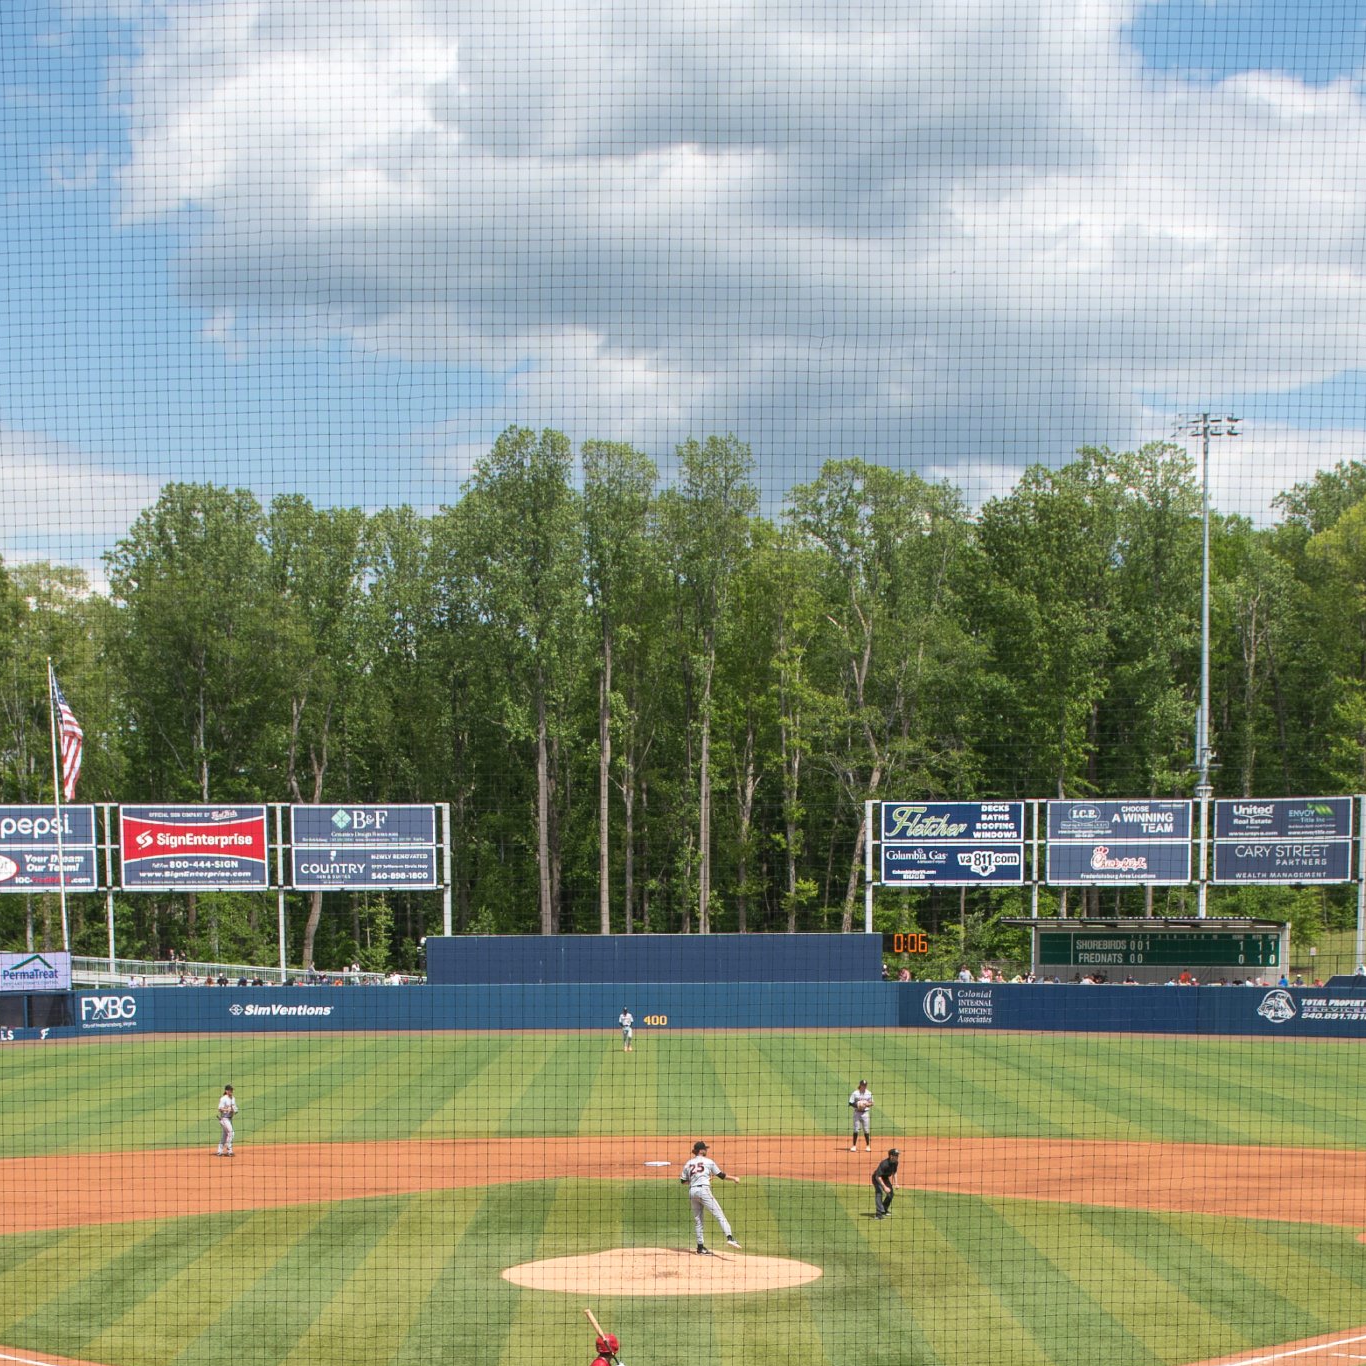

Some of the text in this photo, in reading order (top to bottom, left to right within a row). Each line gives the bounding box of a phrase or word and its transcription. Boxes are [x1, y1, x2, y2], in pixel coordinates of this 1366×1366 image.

[981, 804, 1010, 812] DECKS
[1233, 804, 1275, 816] United
[1288, 809, 1316, 817] ENVOY
[886, 807, 968, 837] Fletcher
[1112, 812, 1174, 823] A WINNING
[0, 813, 70, 839] pepsi
[976, 822, 1015, 830] ROOFING
[1141, 823, 1174, 833] TEAM
[157, 832, 253, 848] SignEnterprise
[973, 831, 1017, 839] WINDOWS
[886, 848, 947, 861] Columbia Gas
[1235, 844, 1329, 858] CARY STREET
[170, 861, 239, 869] 800-444-SIGN
[1276, 858, 1327, 866] PARTNERS
[894, 934, 928, 952] 0:06
[1076, 940, 1126, 950] SHOREBIRDS
[1078, 954, 1123, 963] FREDNATS
[3, 967, 59, 980] PermaTreat
[958, 990, 992, 998] Colonial
[81, 996, 136, 1020] FXBG
[244, 1004, 330, 1016] SimVentions
[958, 1007, 993, 1015] MEDICINE
[957, 1015, 992, 1024] Associates
